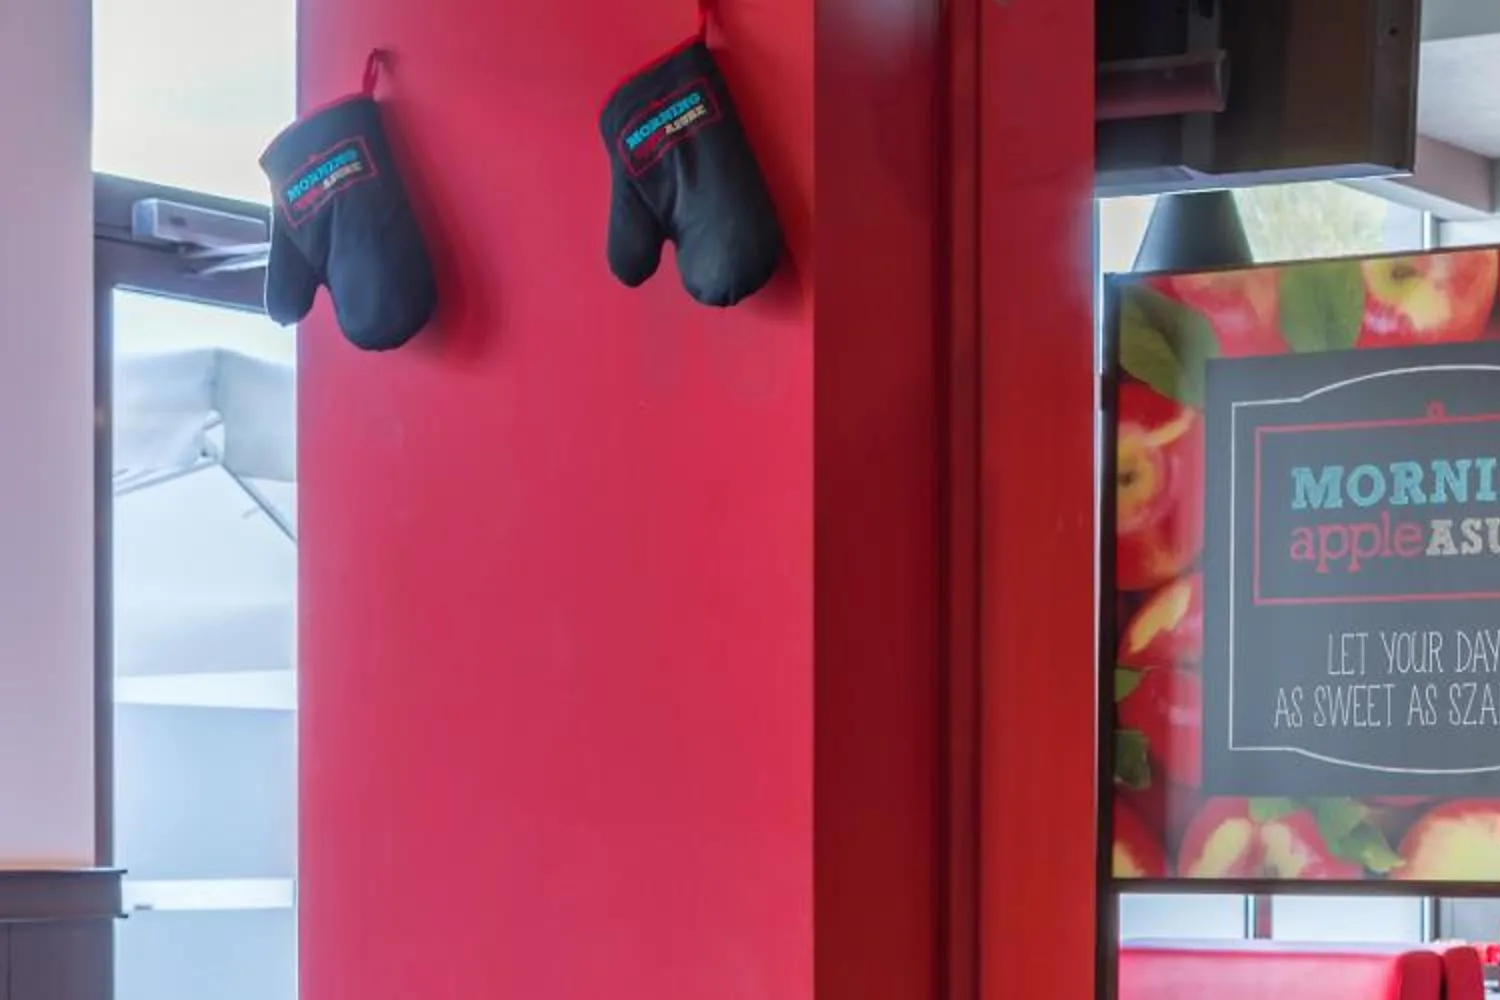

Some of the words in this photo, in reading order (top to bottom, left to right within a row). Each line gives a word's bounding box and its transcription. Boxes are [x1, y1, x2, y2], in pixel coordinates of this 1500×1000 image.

[1327, 632, 1369, 675] LET
[1379, 630, 1444, 674] YOUR
[1274, 685, 1304, 728] AS
[1313, 683, 1396, 728] SWEET
[1407, 683, 1438, 727] AS
